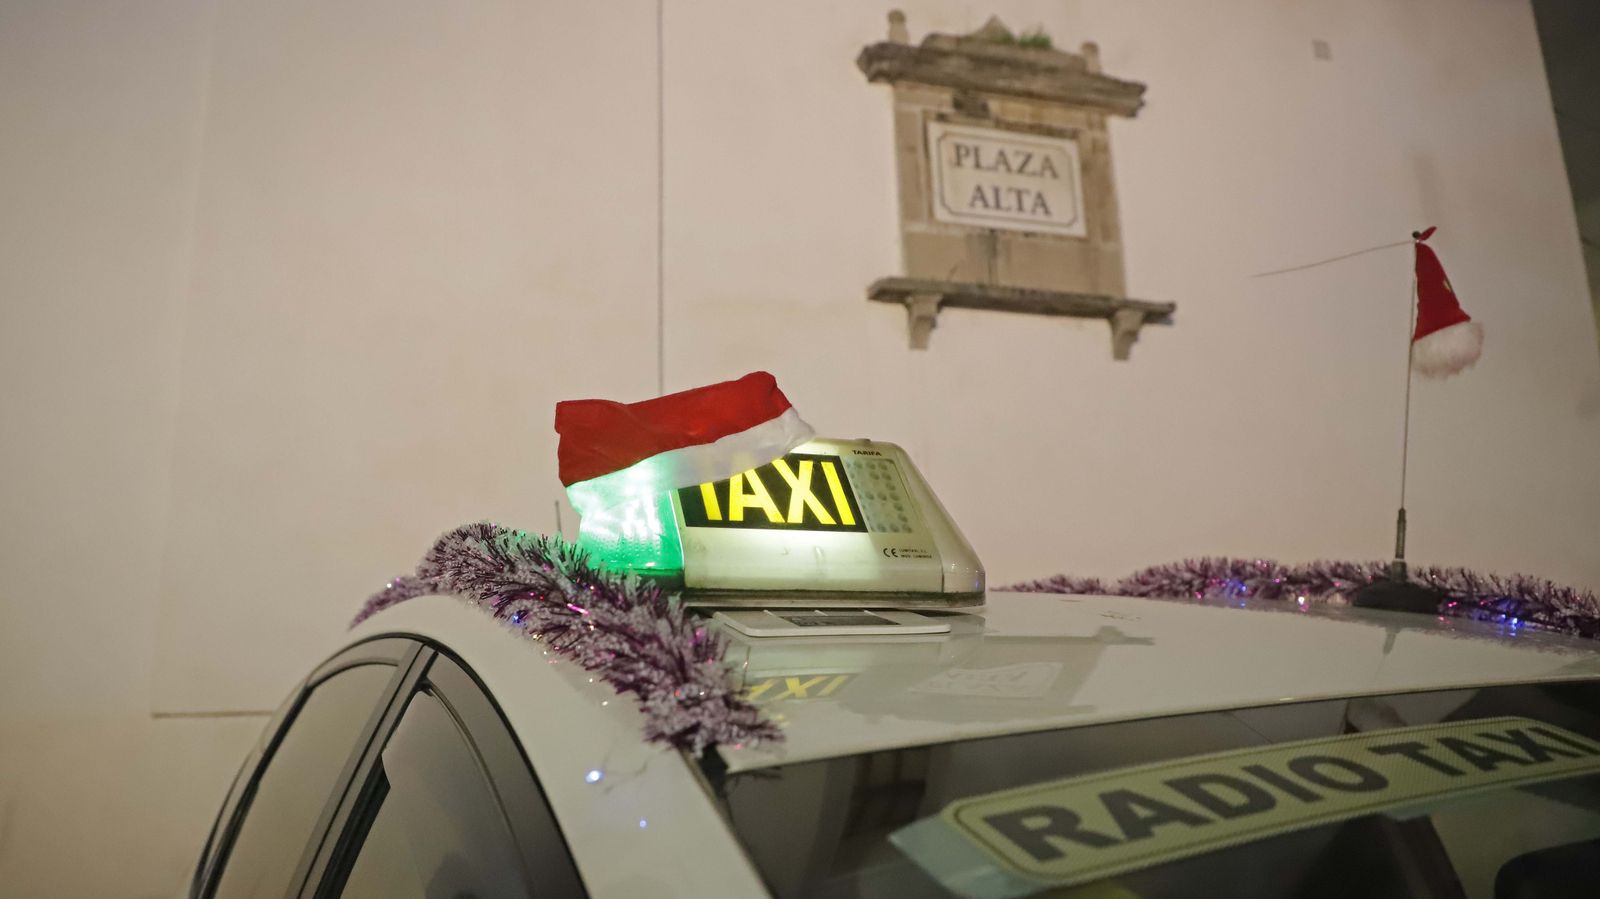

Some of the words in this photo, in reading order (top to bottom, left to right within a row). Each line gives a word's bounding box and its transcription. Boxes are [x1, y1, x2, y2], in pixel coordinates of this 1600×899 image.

[954, 143, 1059, 179] PLAZA
[969, 184, 1052, 216] ALTA
[983, 754, 1389, 863] RADIO
[1367, 727, 1600, 777] TAXI
